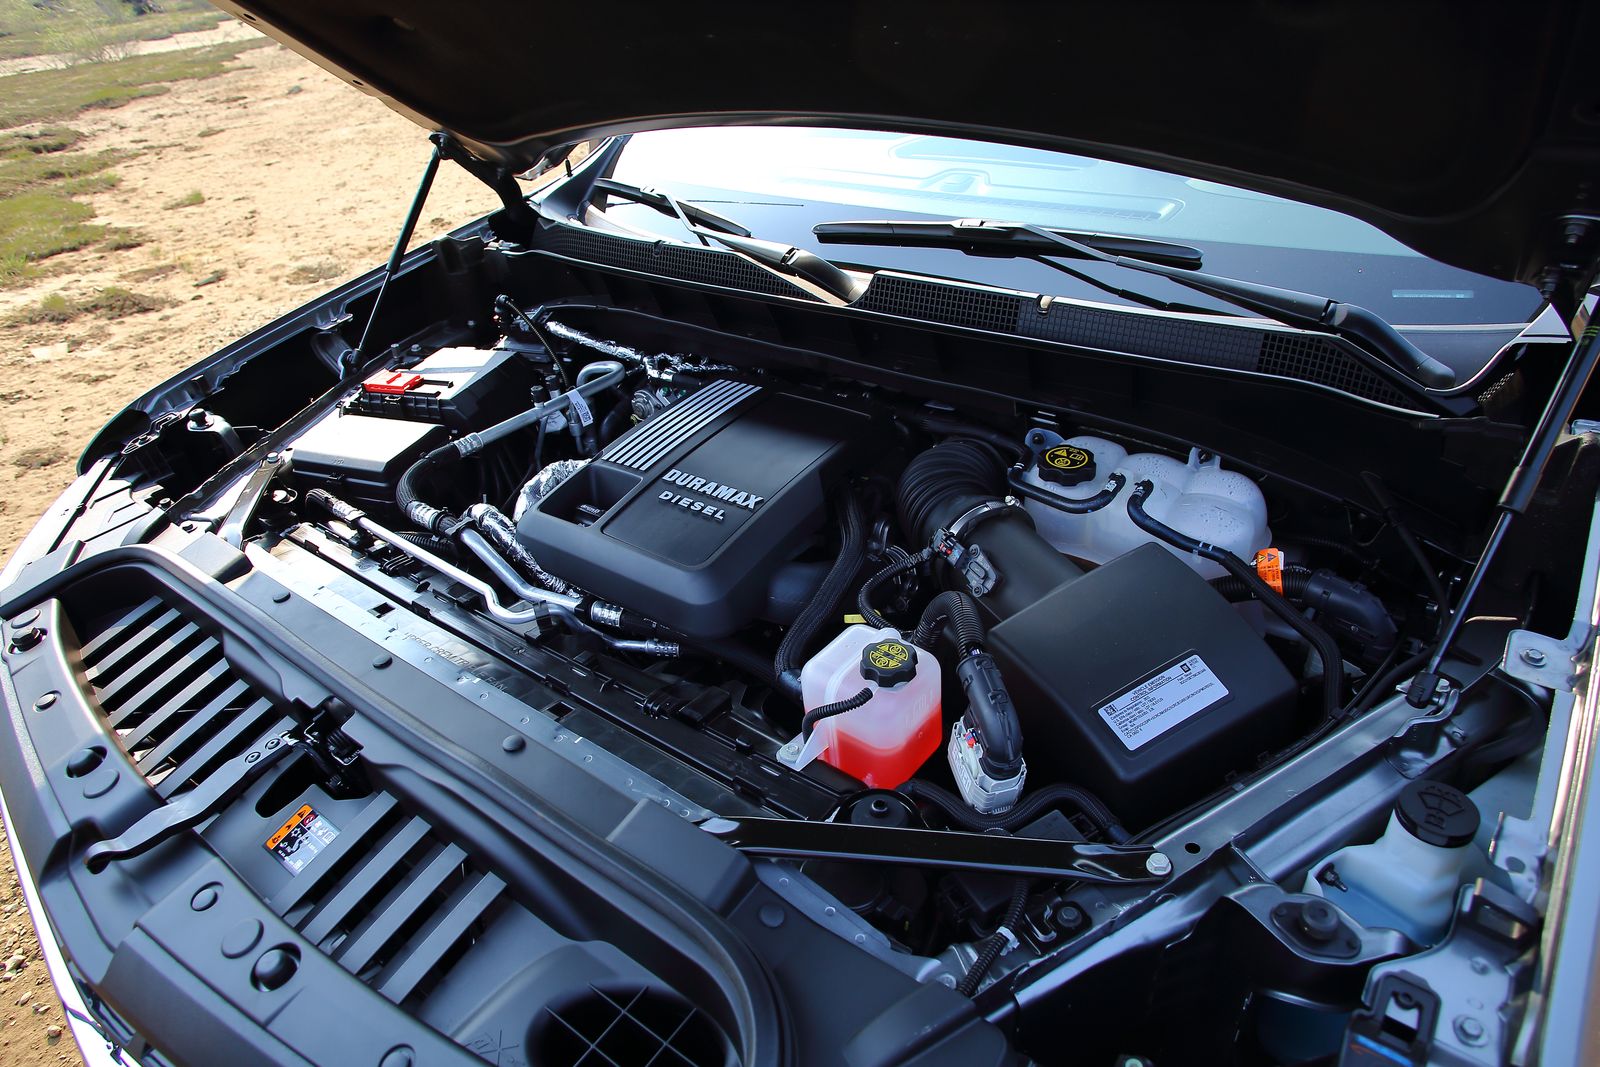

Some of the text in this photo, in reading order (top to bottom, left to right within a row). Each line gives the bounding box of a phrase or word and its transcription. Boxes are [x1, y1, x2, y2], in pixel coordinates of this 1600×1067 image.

[662, 468, 764, 510] DURAMAX
[658, 490, 726, 521] DIESEL
[1130, 690, 1148, 702] CONTROL
[1147, 676, 1173, 692] INFORMATION
